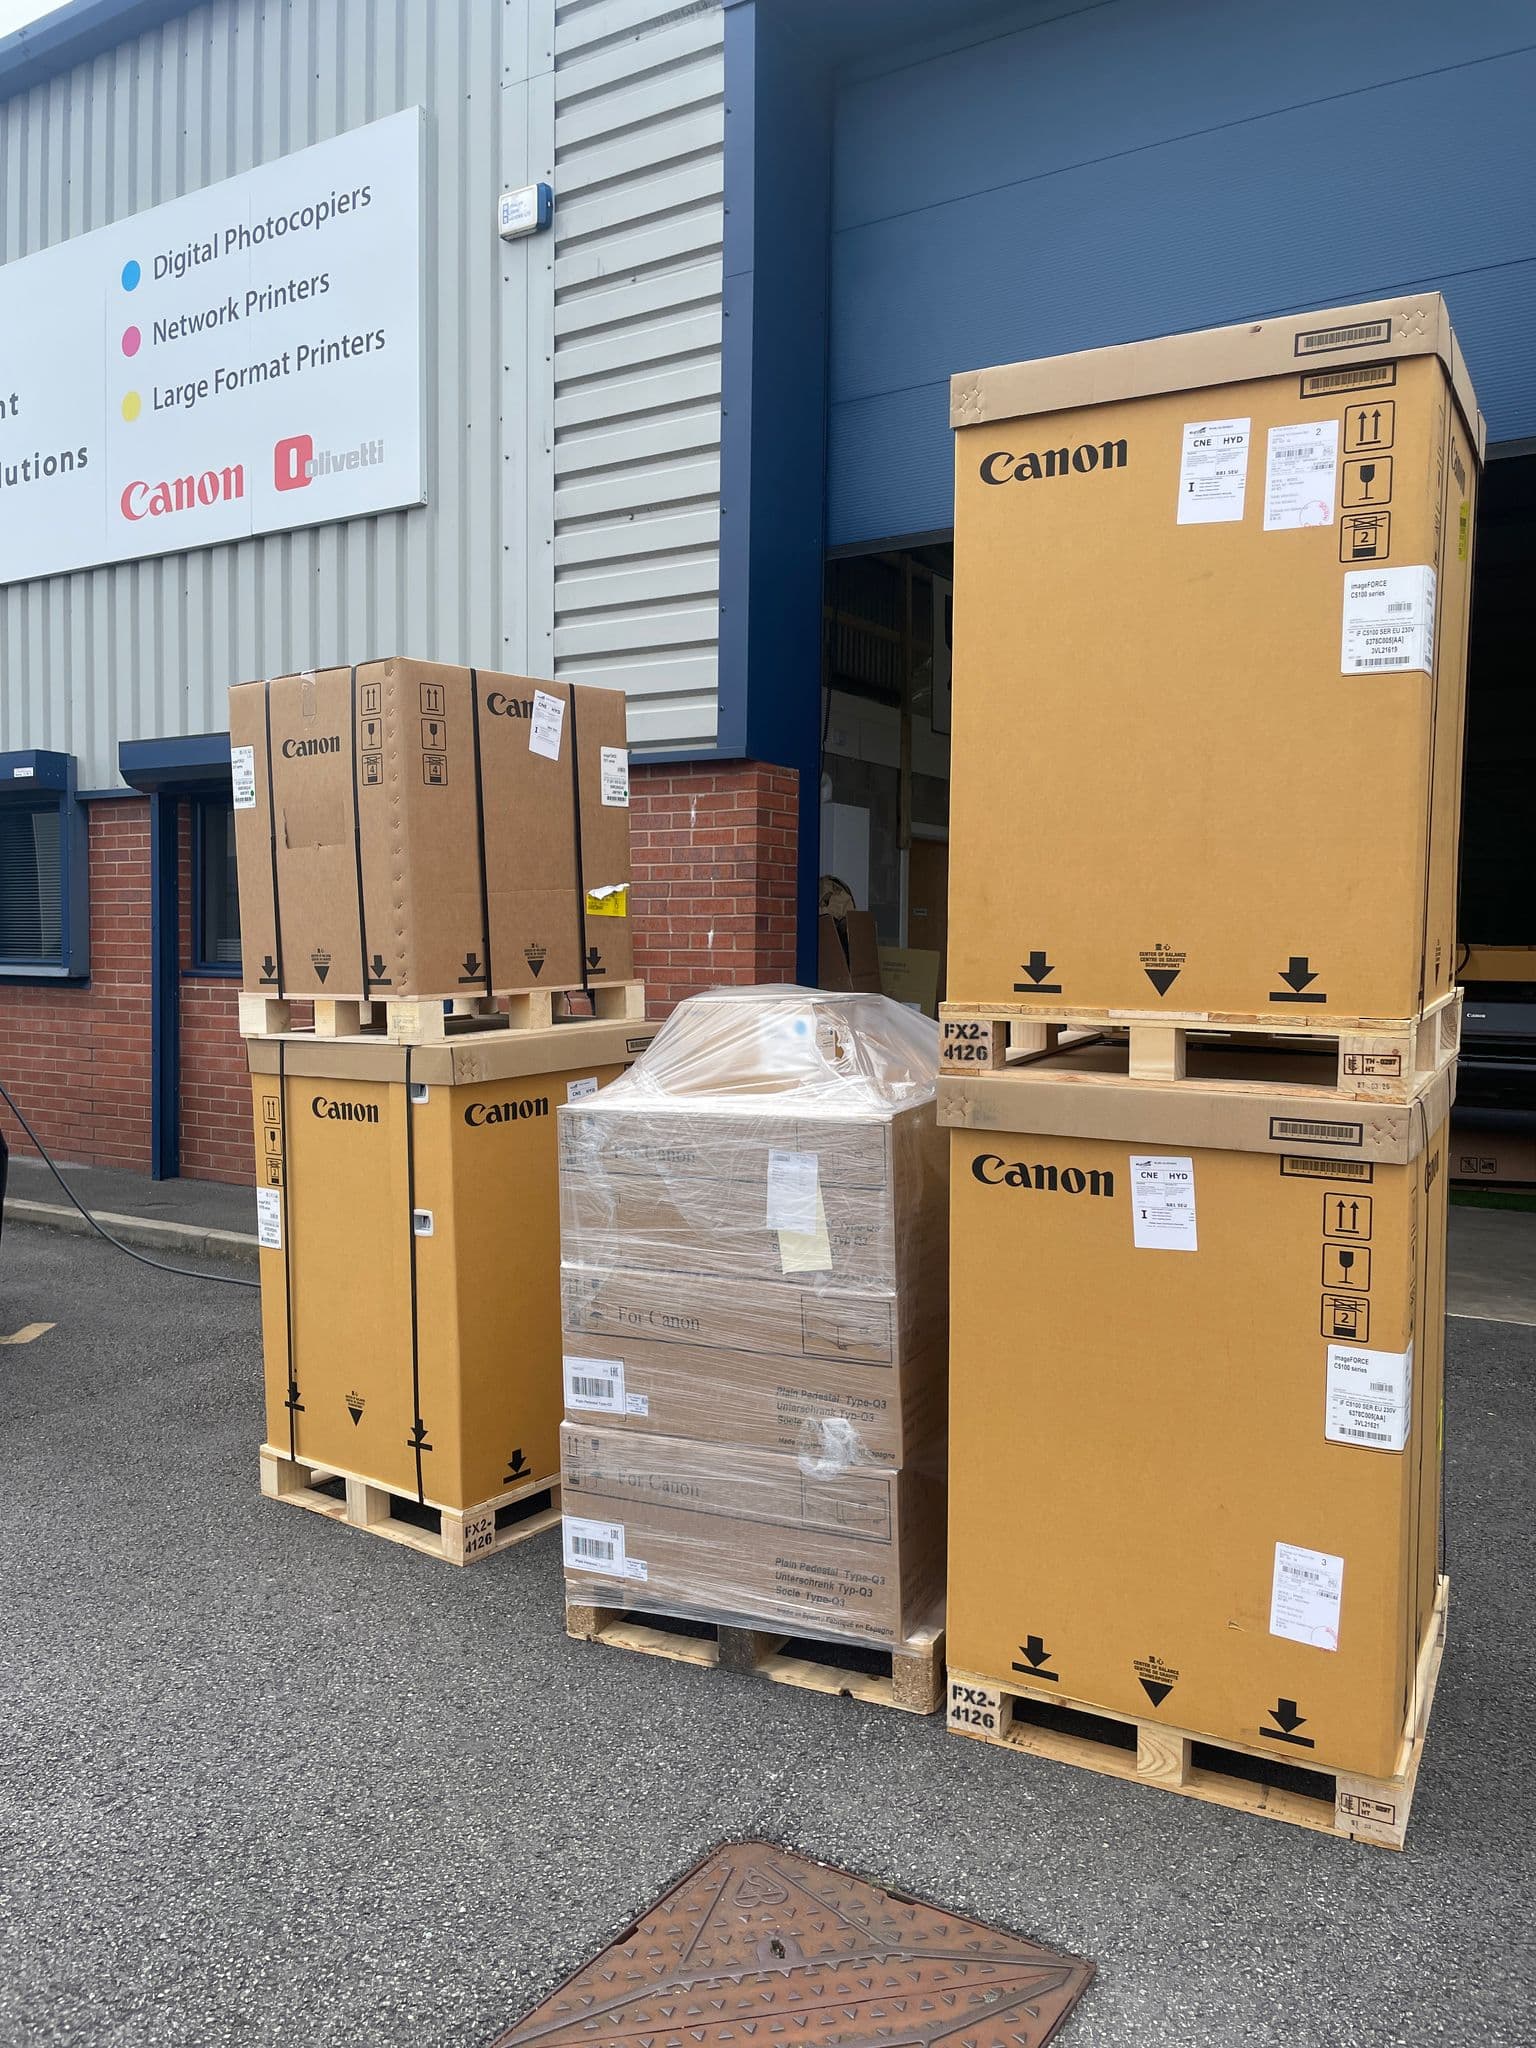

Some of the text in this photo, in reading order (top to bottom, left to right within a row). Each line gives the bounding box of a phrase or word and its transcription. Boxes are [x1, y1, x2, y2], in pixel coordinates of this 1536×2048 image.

[154, 185, 371, 280] Digital Photocopiers
[153, 272, 329, 345] Network Printers
[154, 328, 386, 418] Large Format Printers
[1193, 436, 1244, 448] CNE HYD
[1315, 428, 1322, 436] 2
[979, 438, 1129, 486] Canon
[120, 464, 244, 521] Canon
[1361, 532, 1369, 543] 2
[282, 735, 341, 759] Canon
[945, 1023, 988, 1040] FX2-
[944, 1044, 988, 1061] 4126
[311, 1095, 380, 1123] Canon
[464, 1096, 550, 1128] Canon
[971, 1153, 1114, 1198] Canon
[1141, 1171, 1188, 1180] CNE HYD
[618, 1306, 701, 1332] For Canon
[1341, 1312, 1349, 1323] 2
[1334, 1355, 1369, 1366] imageFORCE
[1351, 1364, 1368, 1374] series
[847, 1395, 887, 1410] Type-Q3
[617, 1468, 700, 1498] For Canon
[465, 1518, 492, 1539] FX2-
[465, 1532, 492, 1553] 4126
[775, 1557, 886, 1586] Plain Pedestal Type-Q3
[1321, 1558, 1327, 1566] 3
[775, 1571, 874, 1599] Unterschrank Typ-Q3
[775, 1585, 846, 1607] Socle Type-Q3
[953, 1685, 995, 1708] FX2-
[951, 1705, 995, 1729] 4126
